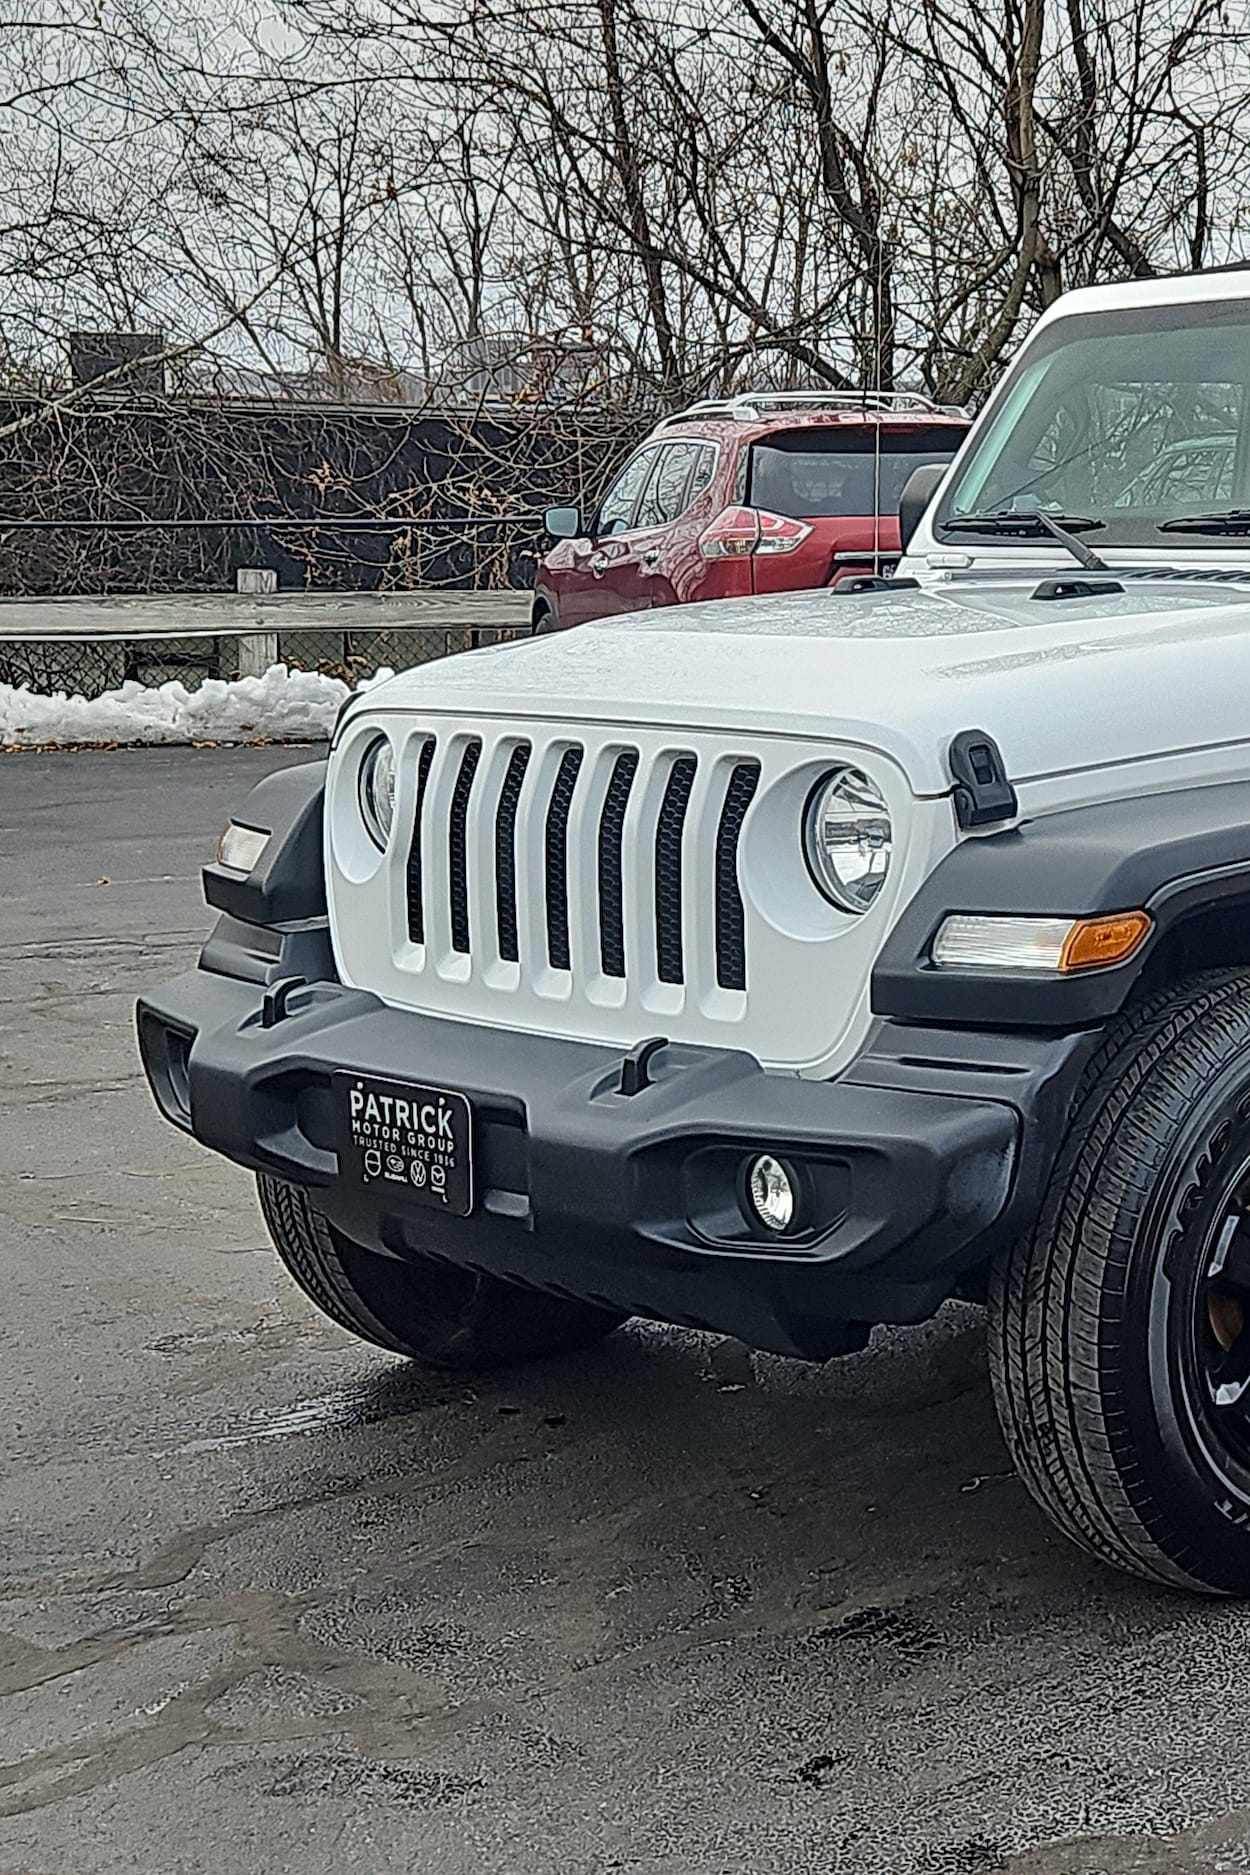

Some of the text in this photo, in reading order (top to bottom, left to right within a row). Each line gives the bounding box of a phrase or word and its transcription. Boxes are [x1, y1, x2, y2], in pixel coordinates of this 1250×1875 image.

[350, 1090, 453, 1139] PATRICK
[352, 1120, 454, 1153] MOTOR GROUP
[353, 1135, 397, 1153] TRUSTED
[401, 1145, 430, 1161] SINCE
